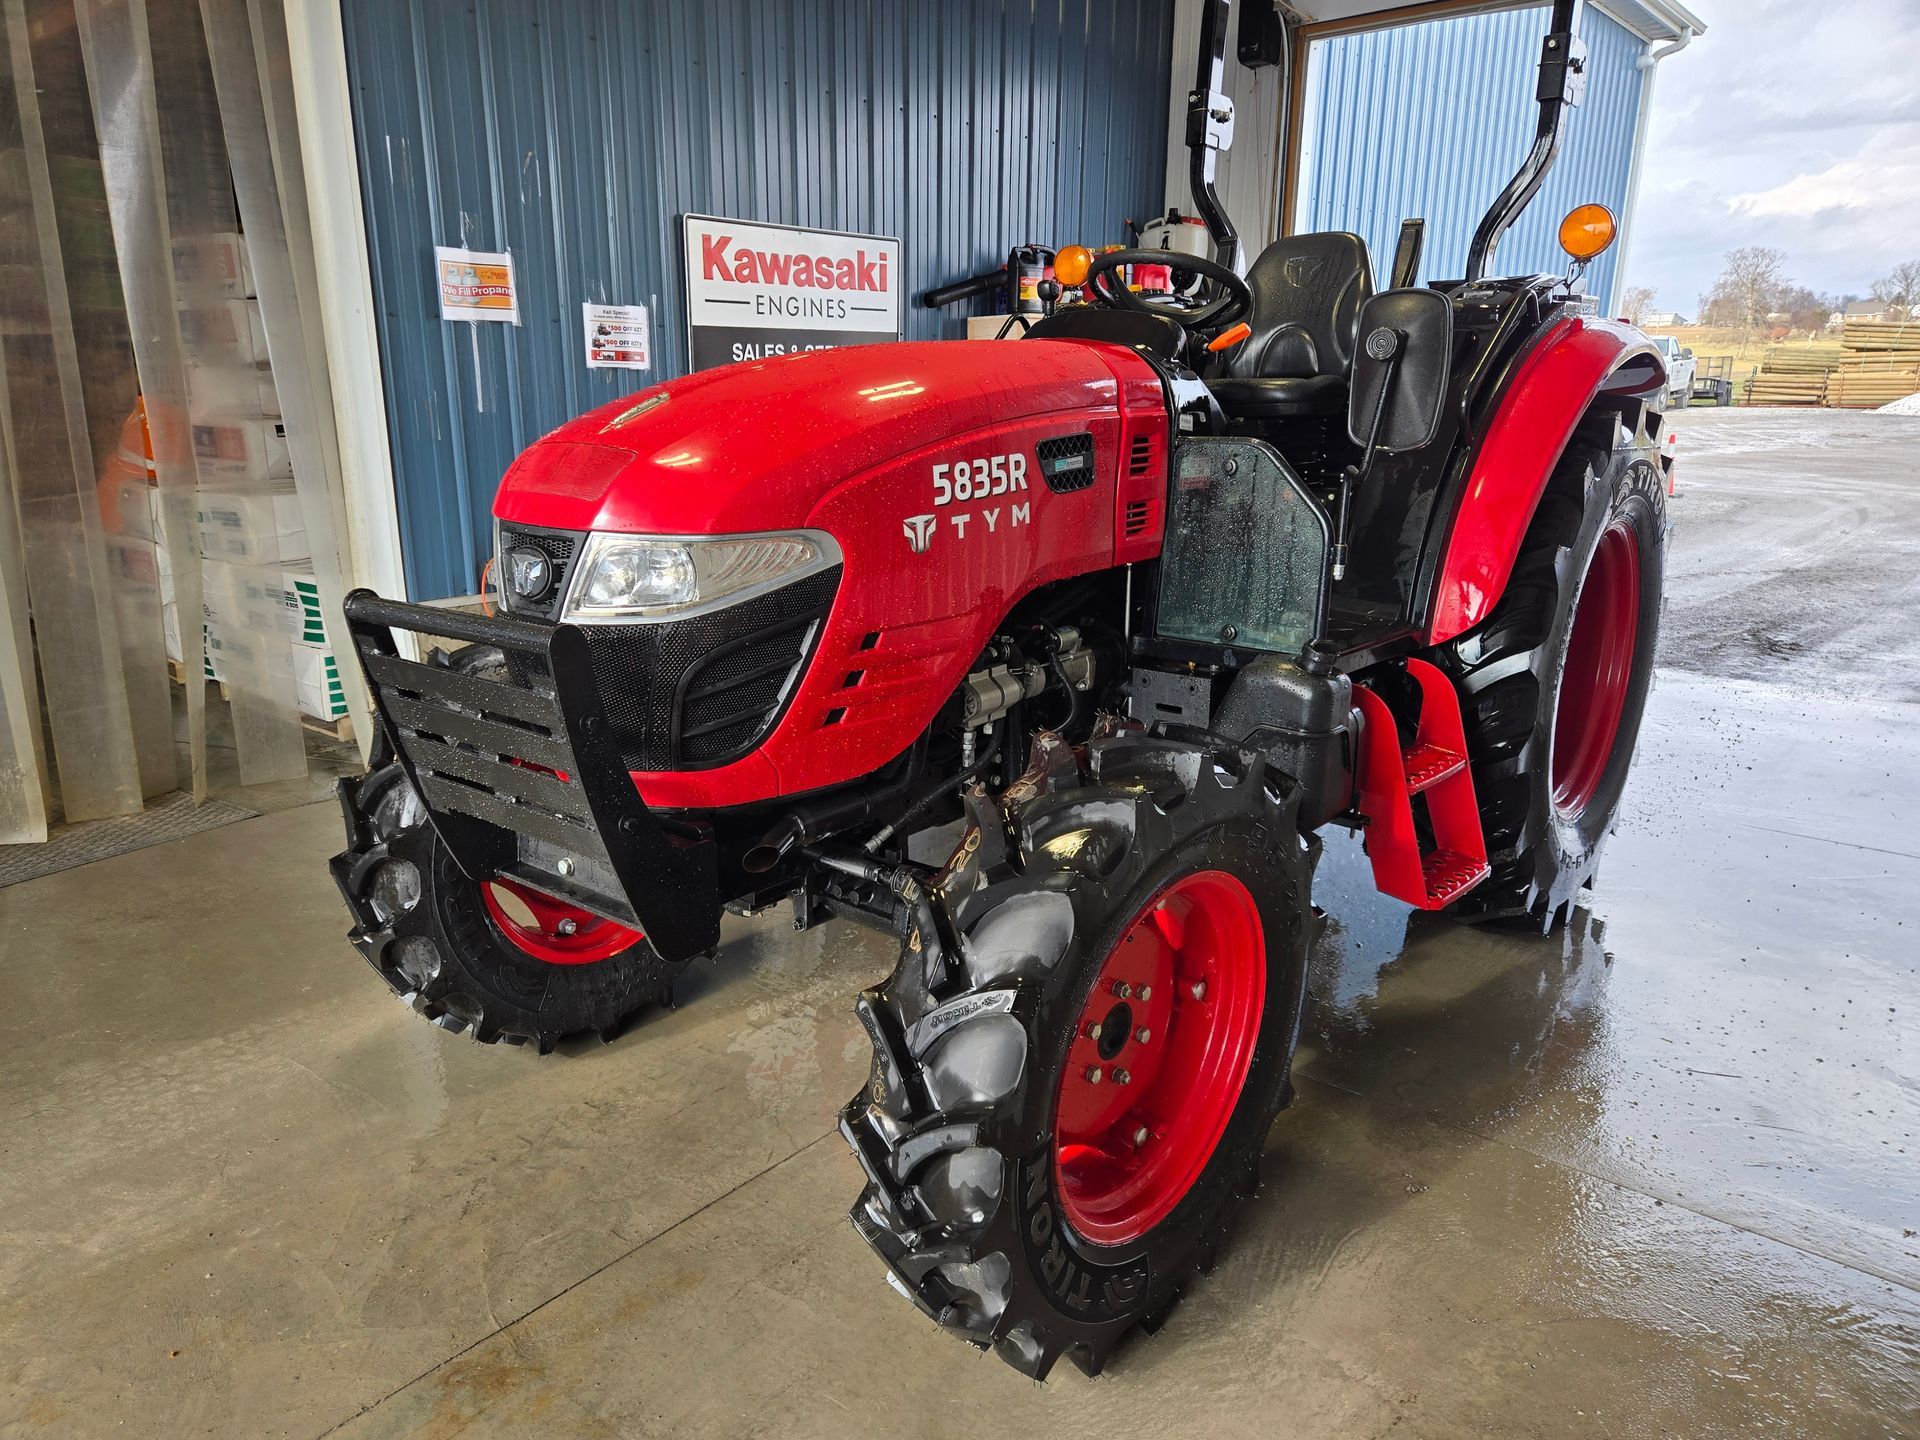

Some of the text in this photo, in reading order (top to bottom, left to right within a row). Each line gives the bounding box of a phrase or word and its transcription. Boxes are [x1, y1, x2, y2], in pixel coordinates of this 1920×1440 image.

[702, 233, 888, 293] Kawasaki
[443, 285, 457, 294] We
[460, 287, 471, 295] Fill
[756, 295, 846, 319] ENGINES
[732, 342, 785, 362] SALES
[932, 452, 1028, 506] 5835R
[951, 501, 1031, 539] TYM
[1026, 1151, 1092, 1311] TIRON
